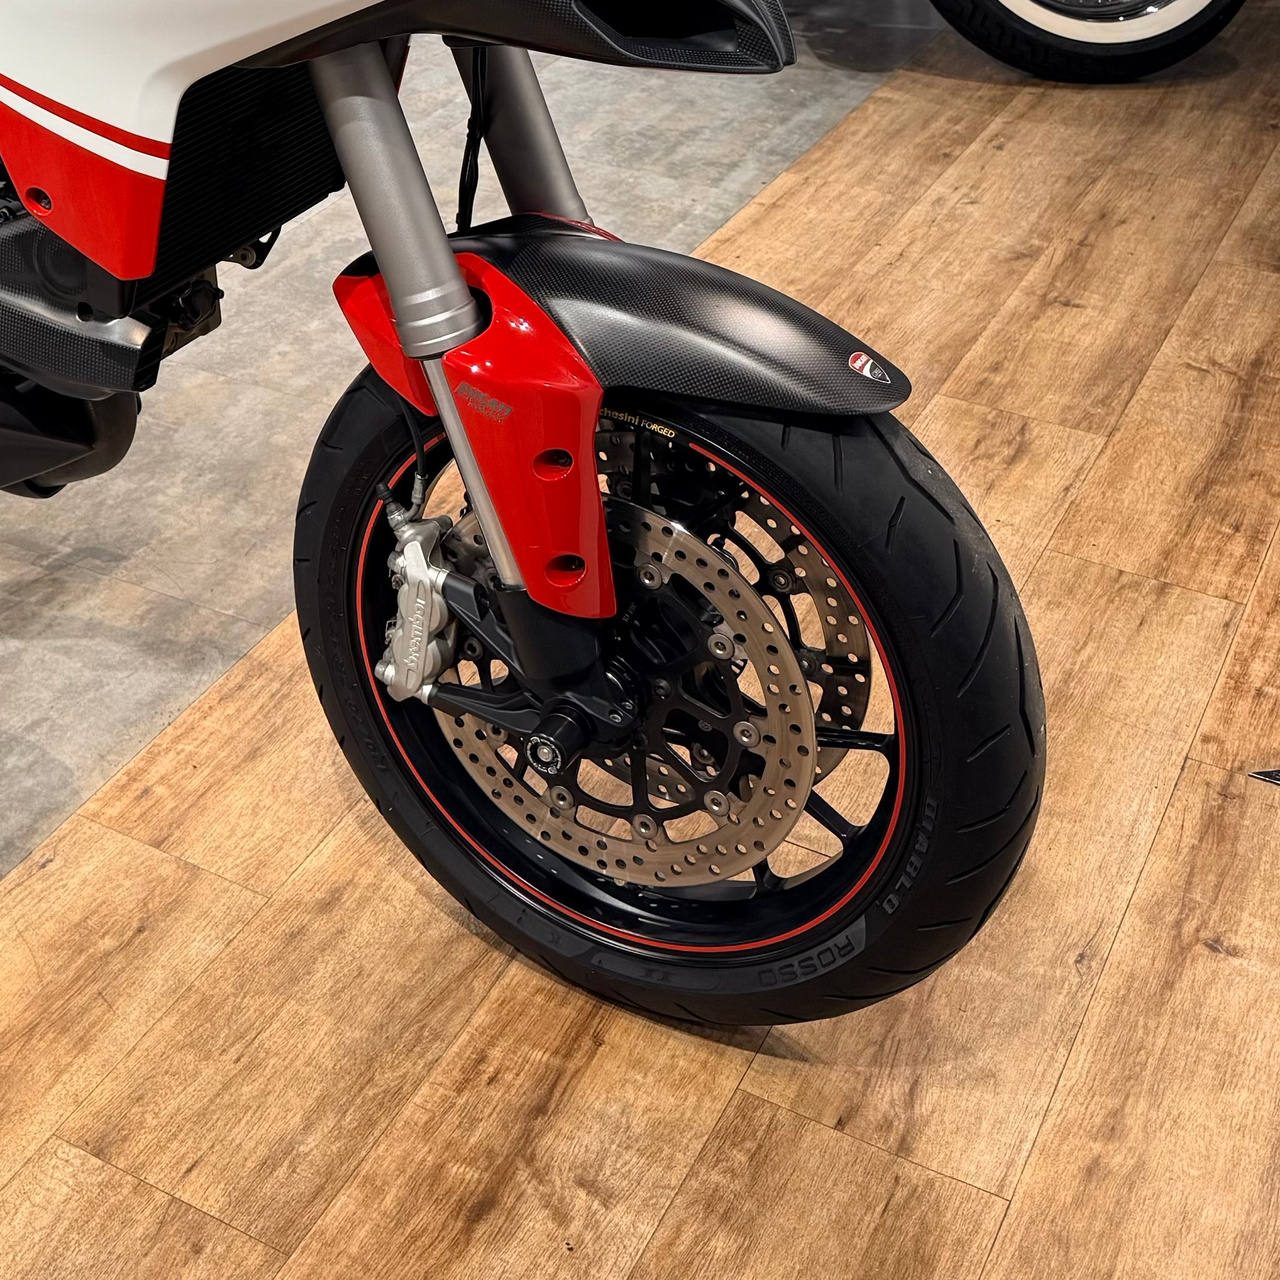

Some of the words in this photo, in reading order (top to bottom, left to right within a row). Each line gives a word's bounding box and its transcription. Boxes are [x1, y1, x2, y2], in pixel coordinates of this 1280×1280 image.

[599, 407, 640, 425] chesini
[640, 420, 676, 438] FORGED
[883, 800, 939, 915] DIABLO
[759, 934, 856, 987] ROSSO
